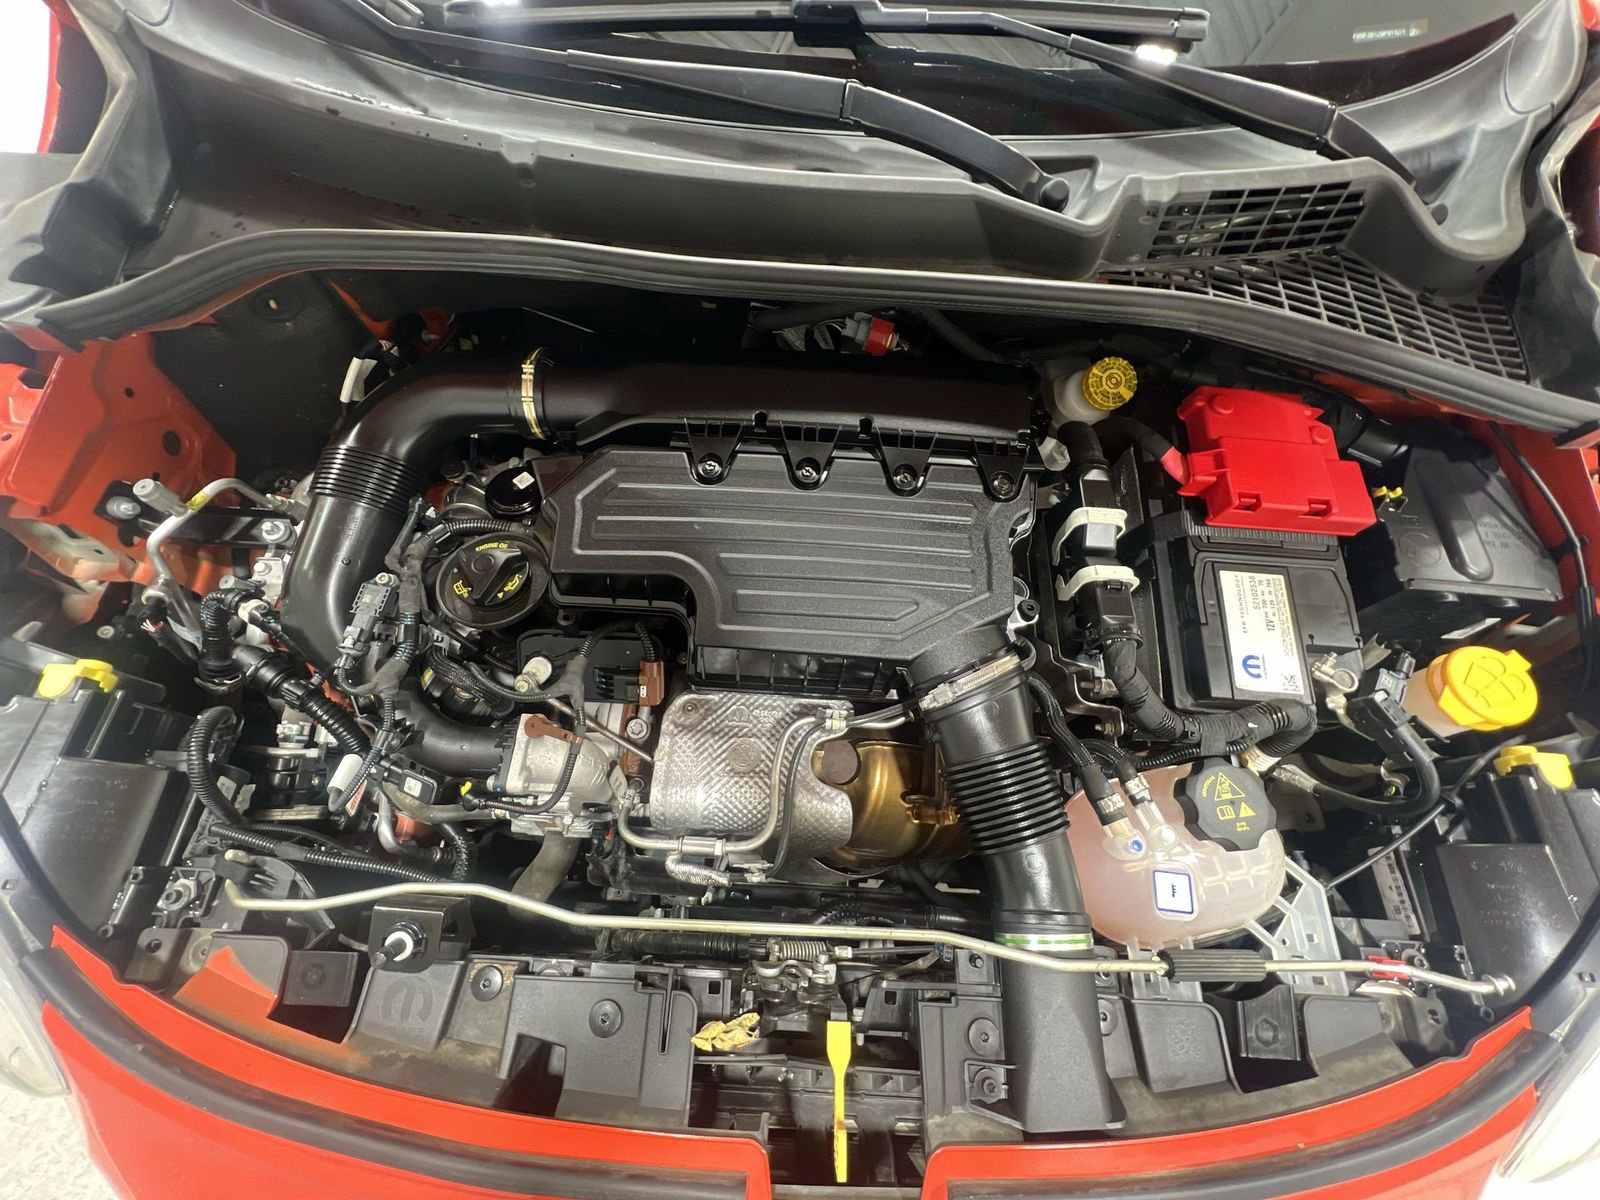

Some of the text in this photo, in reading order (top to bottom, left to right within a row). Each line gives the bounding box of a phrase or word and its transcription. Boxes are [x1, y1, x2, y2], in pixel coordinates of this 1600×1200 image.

[475, 543, 498, 551] ENGINE
[1235, 575, 1244, 618] TECHNOLOGY
[1265, 619, 1275, 631] 12V
